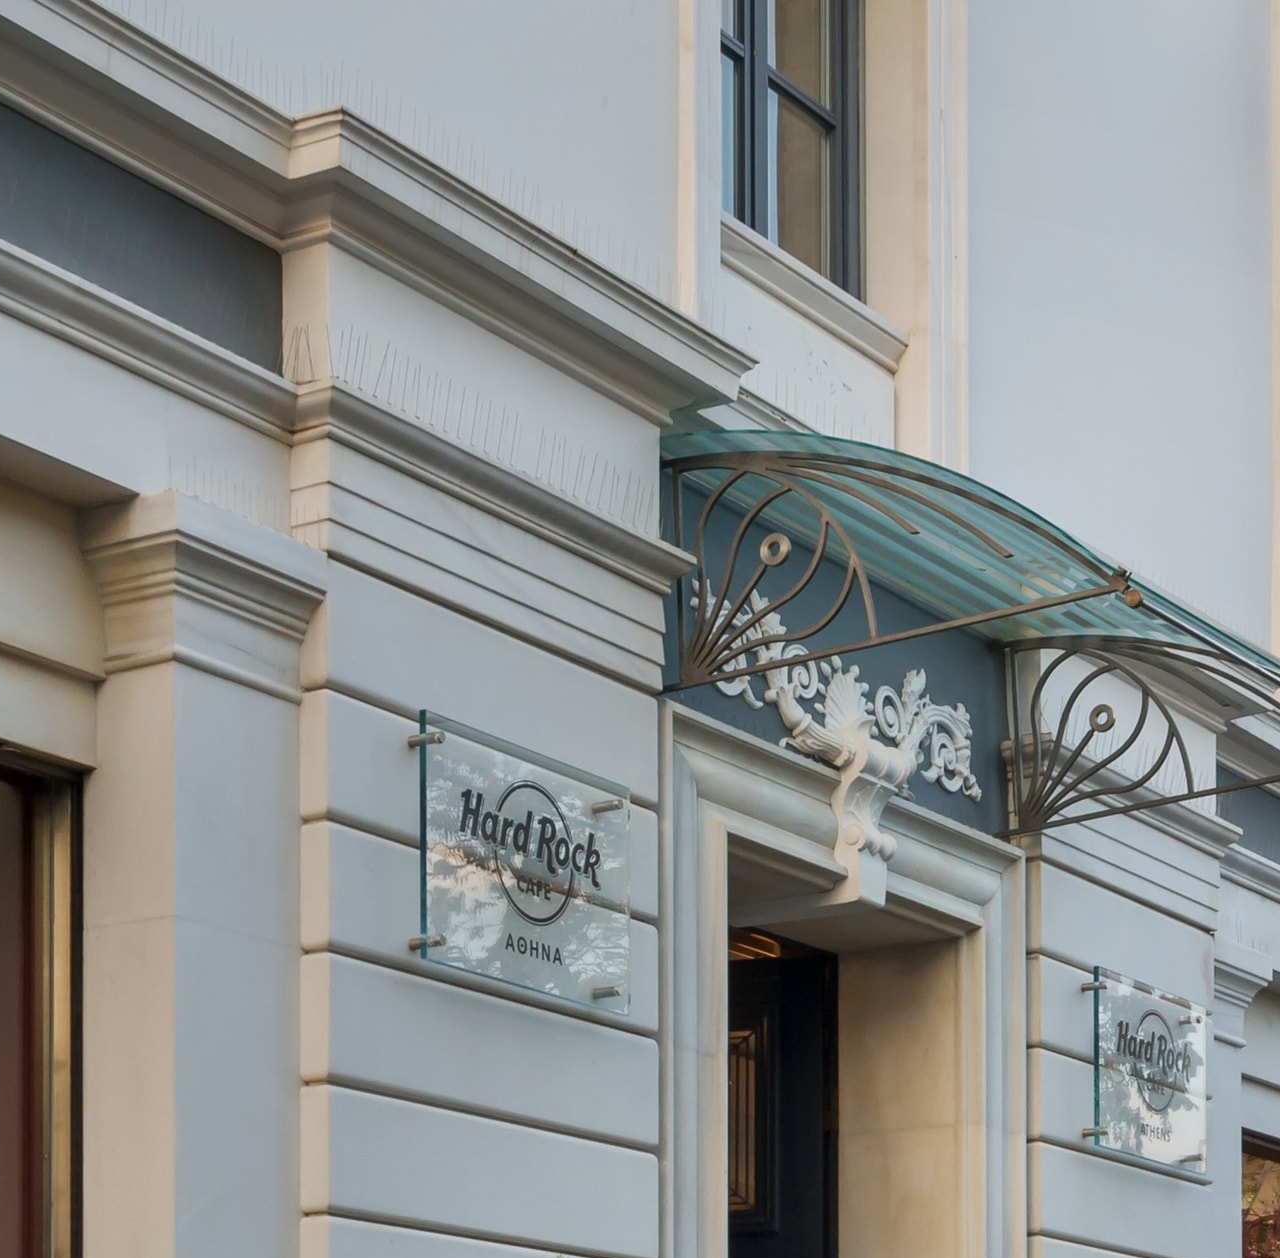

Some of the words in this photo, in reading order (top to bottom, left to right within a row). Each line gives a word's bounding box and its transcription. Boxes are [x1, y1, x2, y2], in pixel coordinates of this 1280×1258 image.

[459, 788, 533, 854] Hard
[537, 817, 602, 890] Rock
[516, 876, 552, 901] CAFE
[1116, 1020, 1155, 1065] Hard
[1157, 1033, 1191, 1083] Rock
[1146, 1076, 1166, 1097] CAFE
[1140, 1121, 1172, 1143] ATHENS
